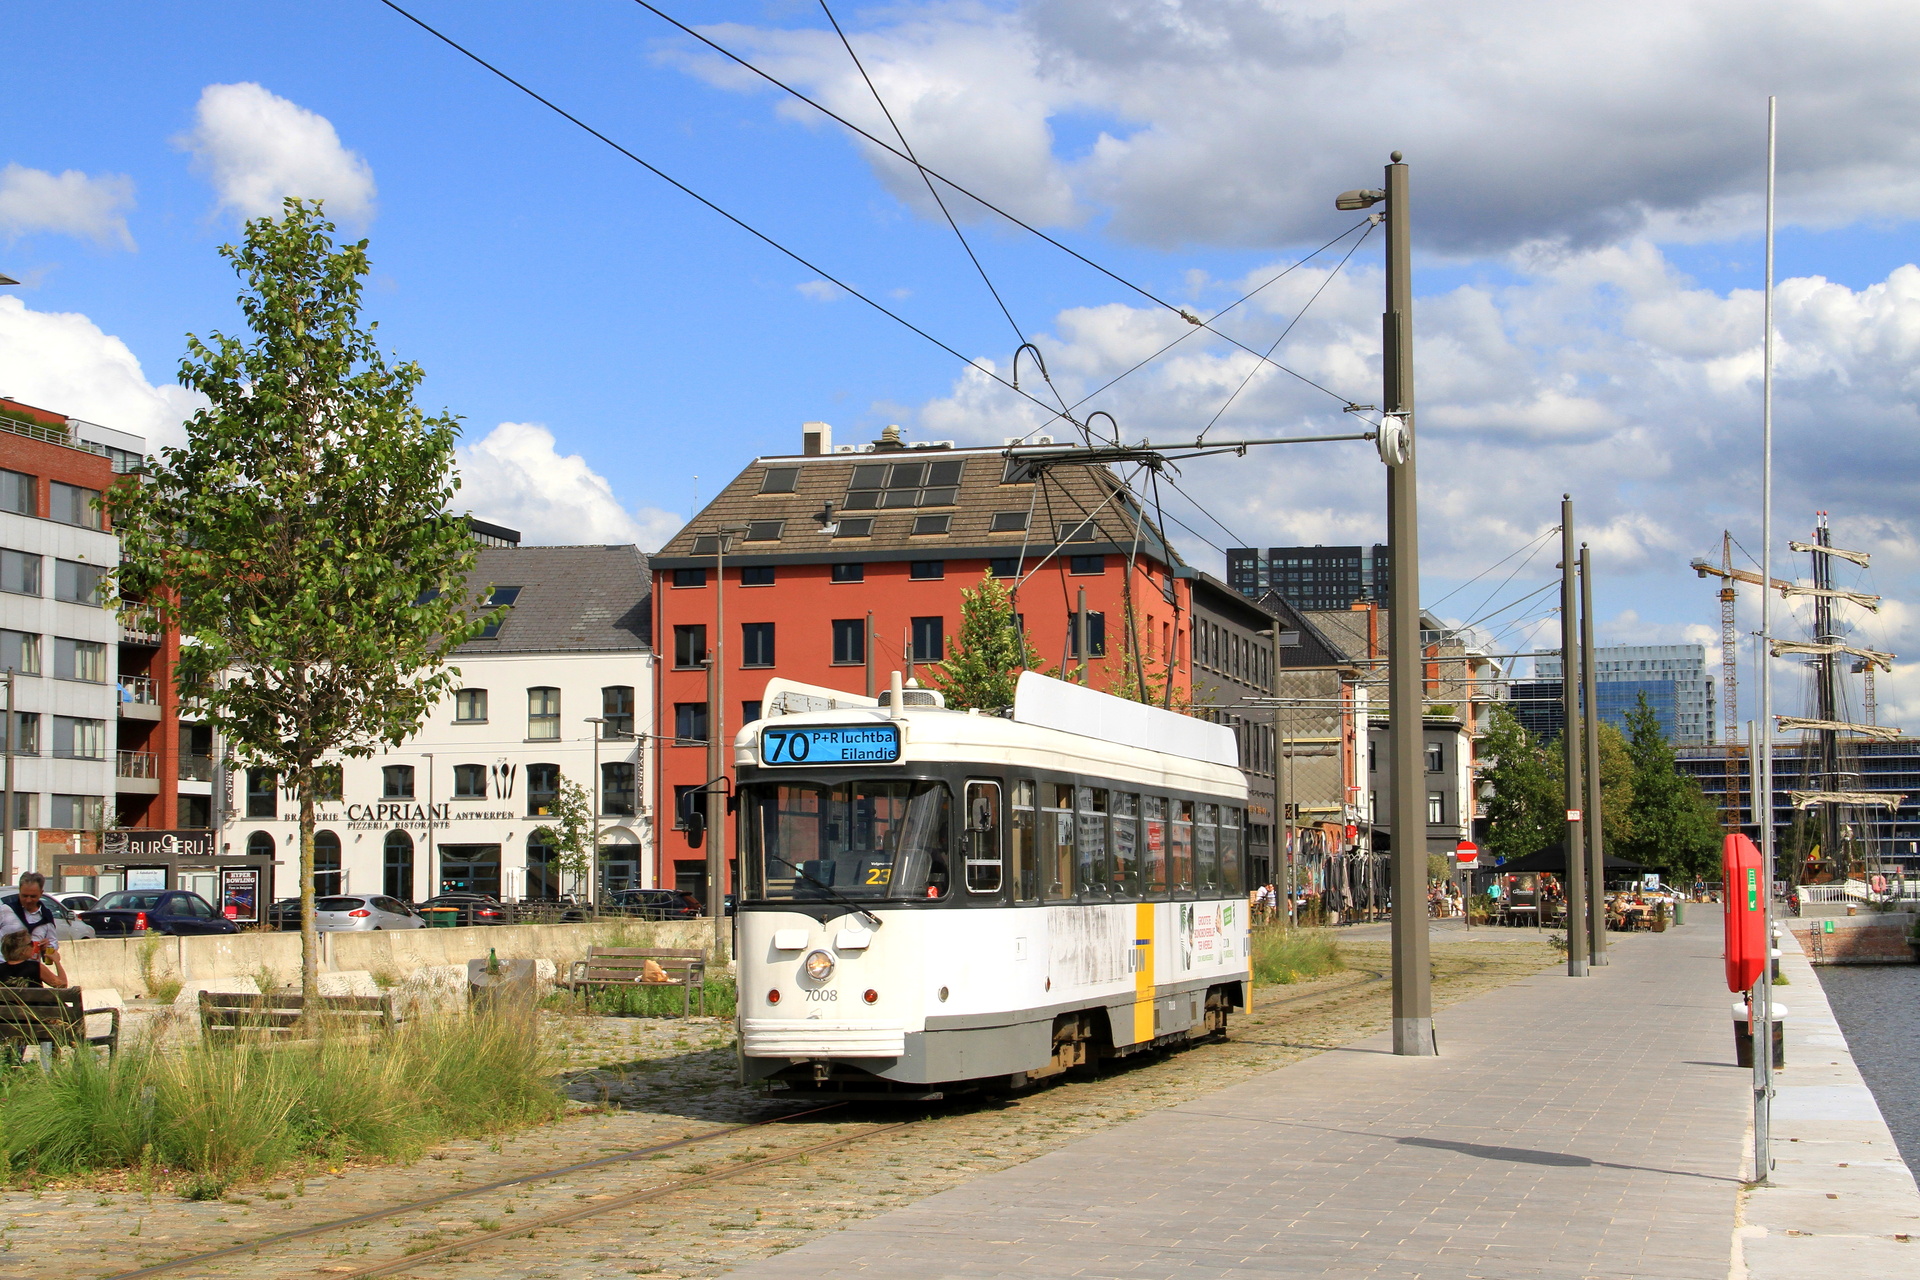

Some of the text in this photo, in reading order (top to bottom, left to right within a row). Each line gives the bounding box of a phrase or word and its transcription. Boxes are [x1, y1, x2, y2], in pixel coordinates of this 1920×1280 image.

[813, 730, 897, 744] P+R luchtbal
[768, 733, 810, 762] 70
[841, 748, 896, 761] Eilandje
[284, 803, 515, 821] BRERIE CAPRIANI ANTWERPEN
[347, 821, 389, 830] PIZZERIA
[131, 834, 204, 855] BURGERIJ
[865, 868, 892, 885] 23
[804, 989, 838, 1002] 7008
